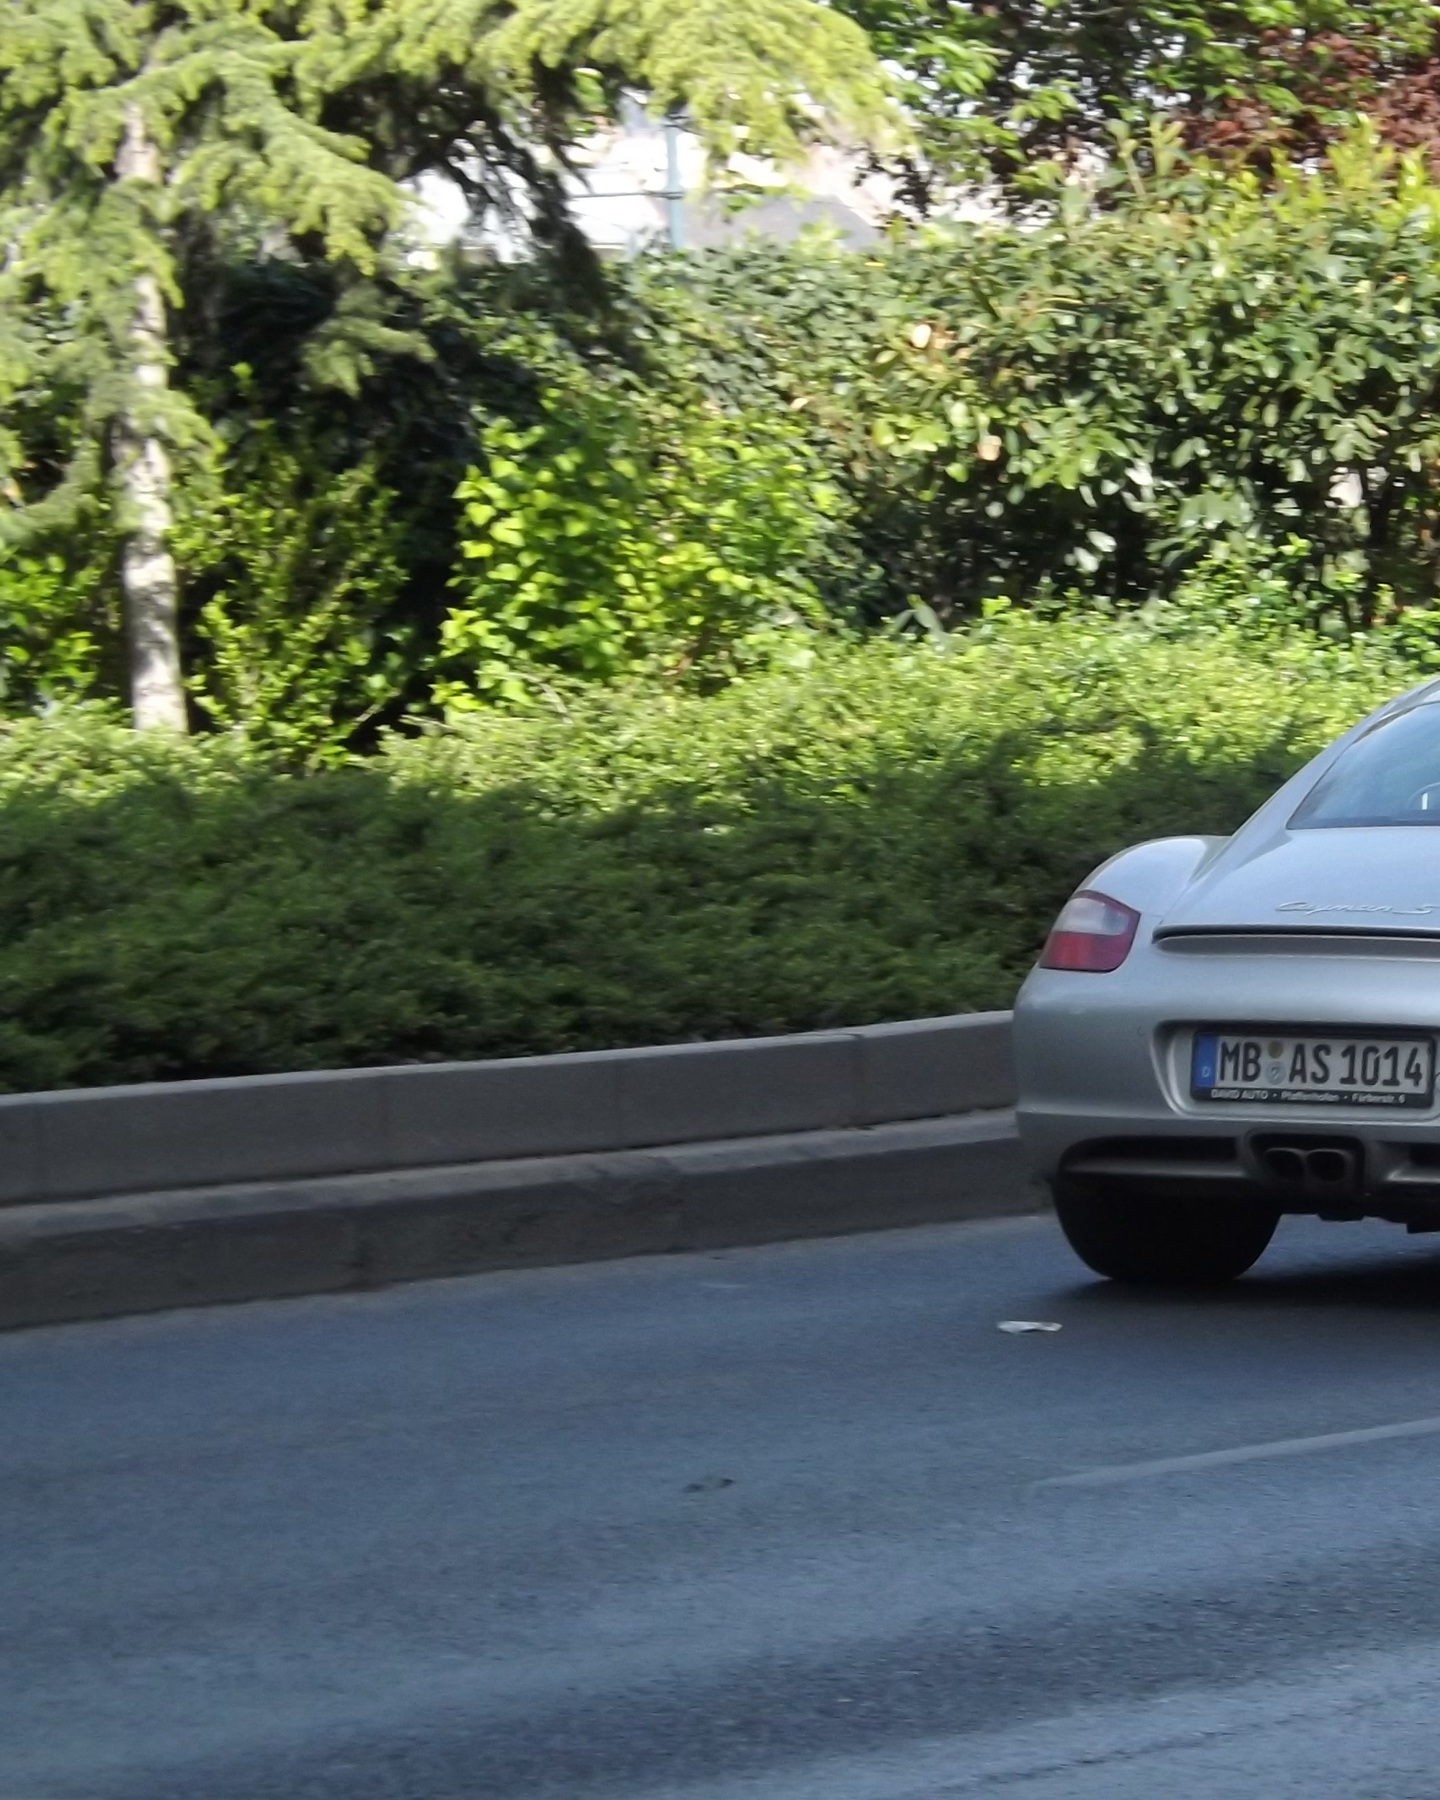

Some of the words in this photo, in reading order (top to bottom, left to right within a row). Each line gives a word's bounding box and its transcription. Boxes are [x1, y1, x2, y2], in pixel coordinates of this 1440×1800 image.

[1275, 901, 1393, 916] Cayman
[1219, 1041, 1262, 1082] MB
[1288, 1043, 1331, 1084] AS
[1339, 1045, 1423, 1087] 1014
[1211, 1089, 1239, 1099] DAVID
[1240, 1090, 1269, 1100] AUTO
